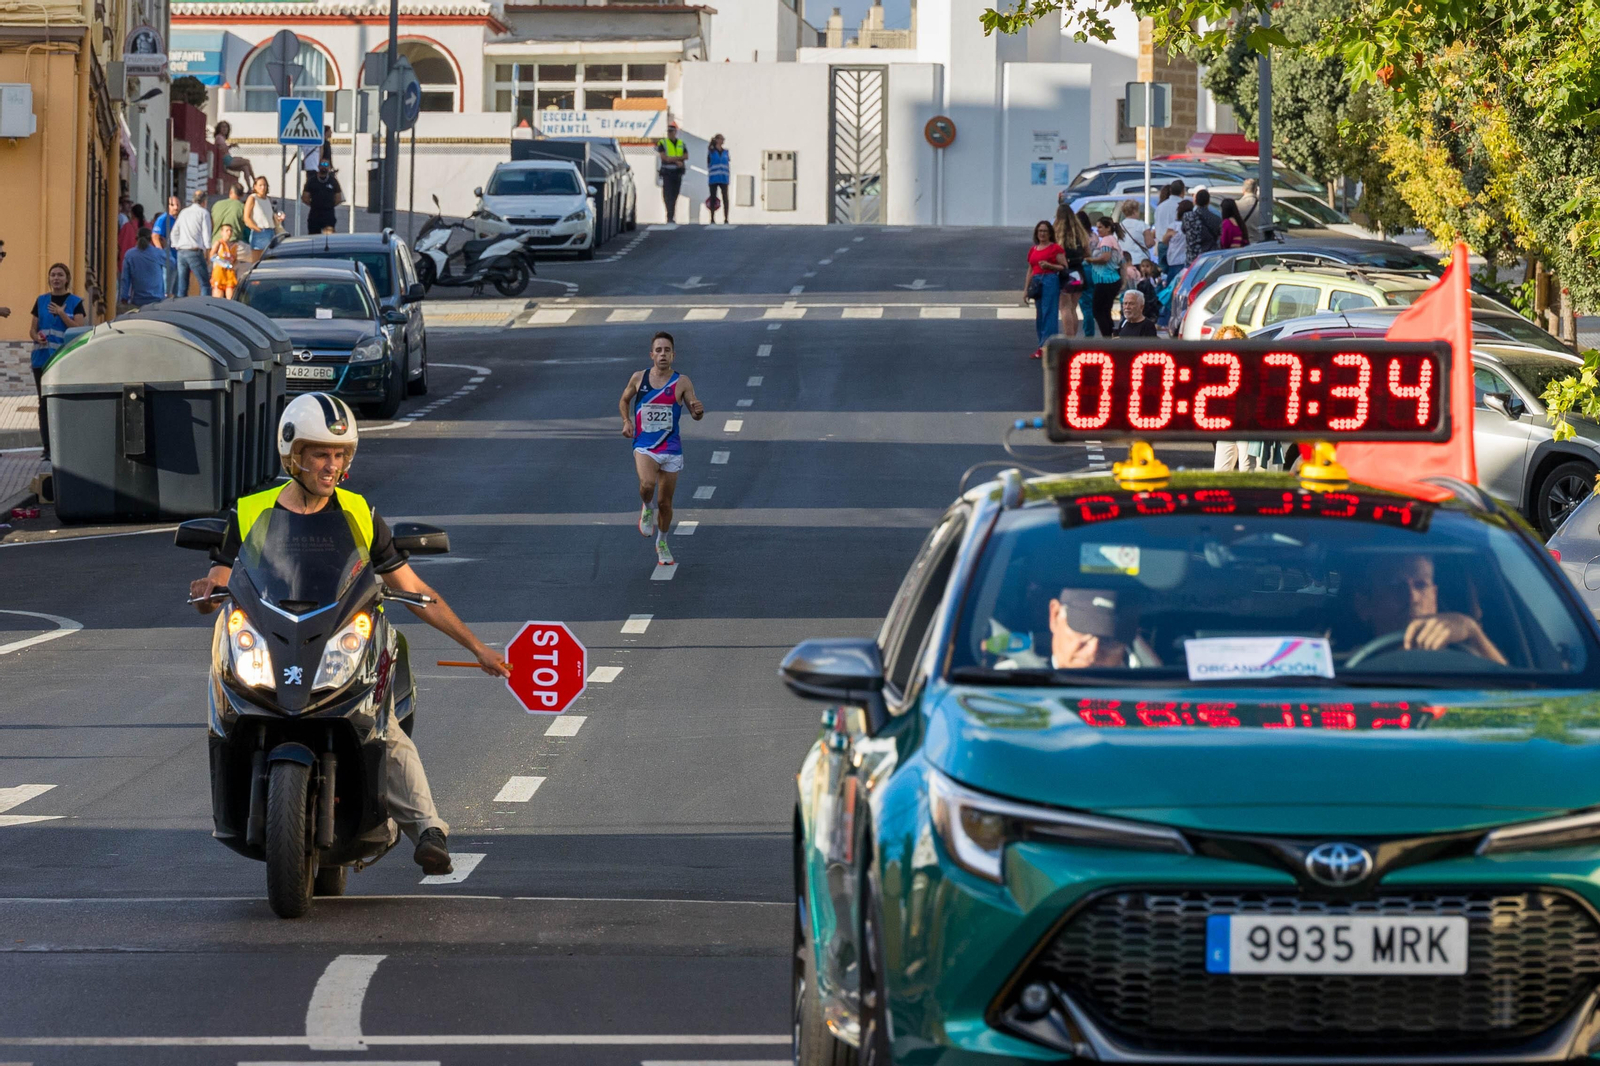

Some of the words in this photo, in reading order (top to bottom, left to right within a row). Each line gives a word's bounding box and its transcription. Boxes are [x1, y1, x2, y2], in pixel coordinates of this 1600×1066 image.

[542, 112, 588, 122] ESCUELA
[542, 125, 592, 134] INFANTIL
[313, 368, 333, 378] GBC
[1066, 351, 1432, 430] 00:27:34
[646, 411, 668, 422] 322
[532, 629, 560, 707] STOP
[1196, 661, 1318, 674] ORGANIZACIÓN
[1247, 925, 1354, 963] 9935
[1372, 926, 1450, 964] MRK
